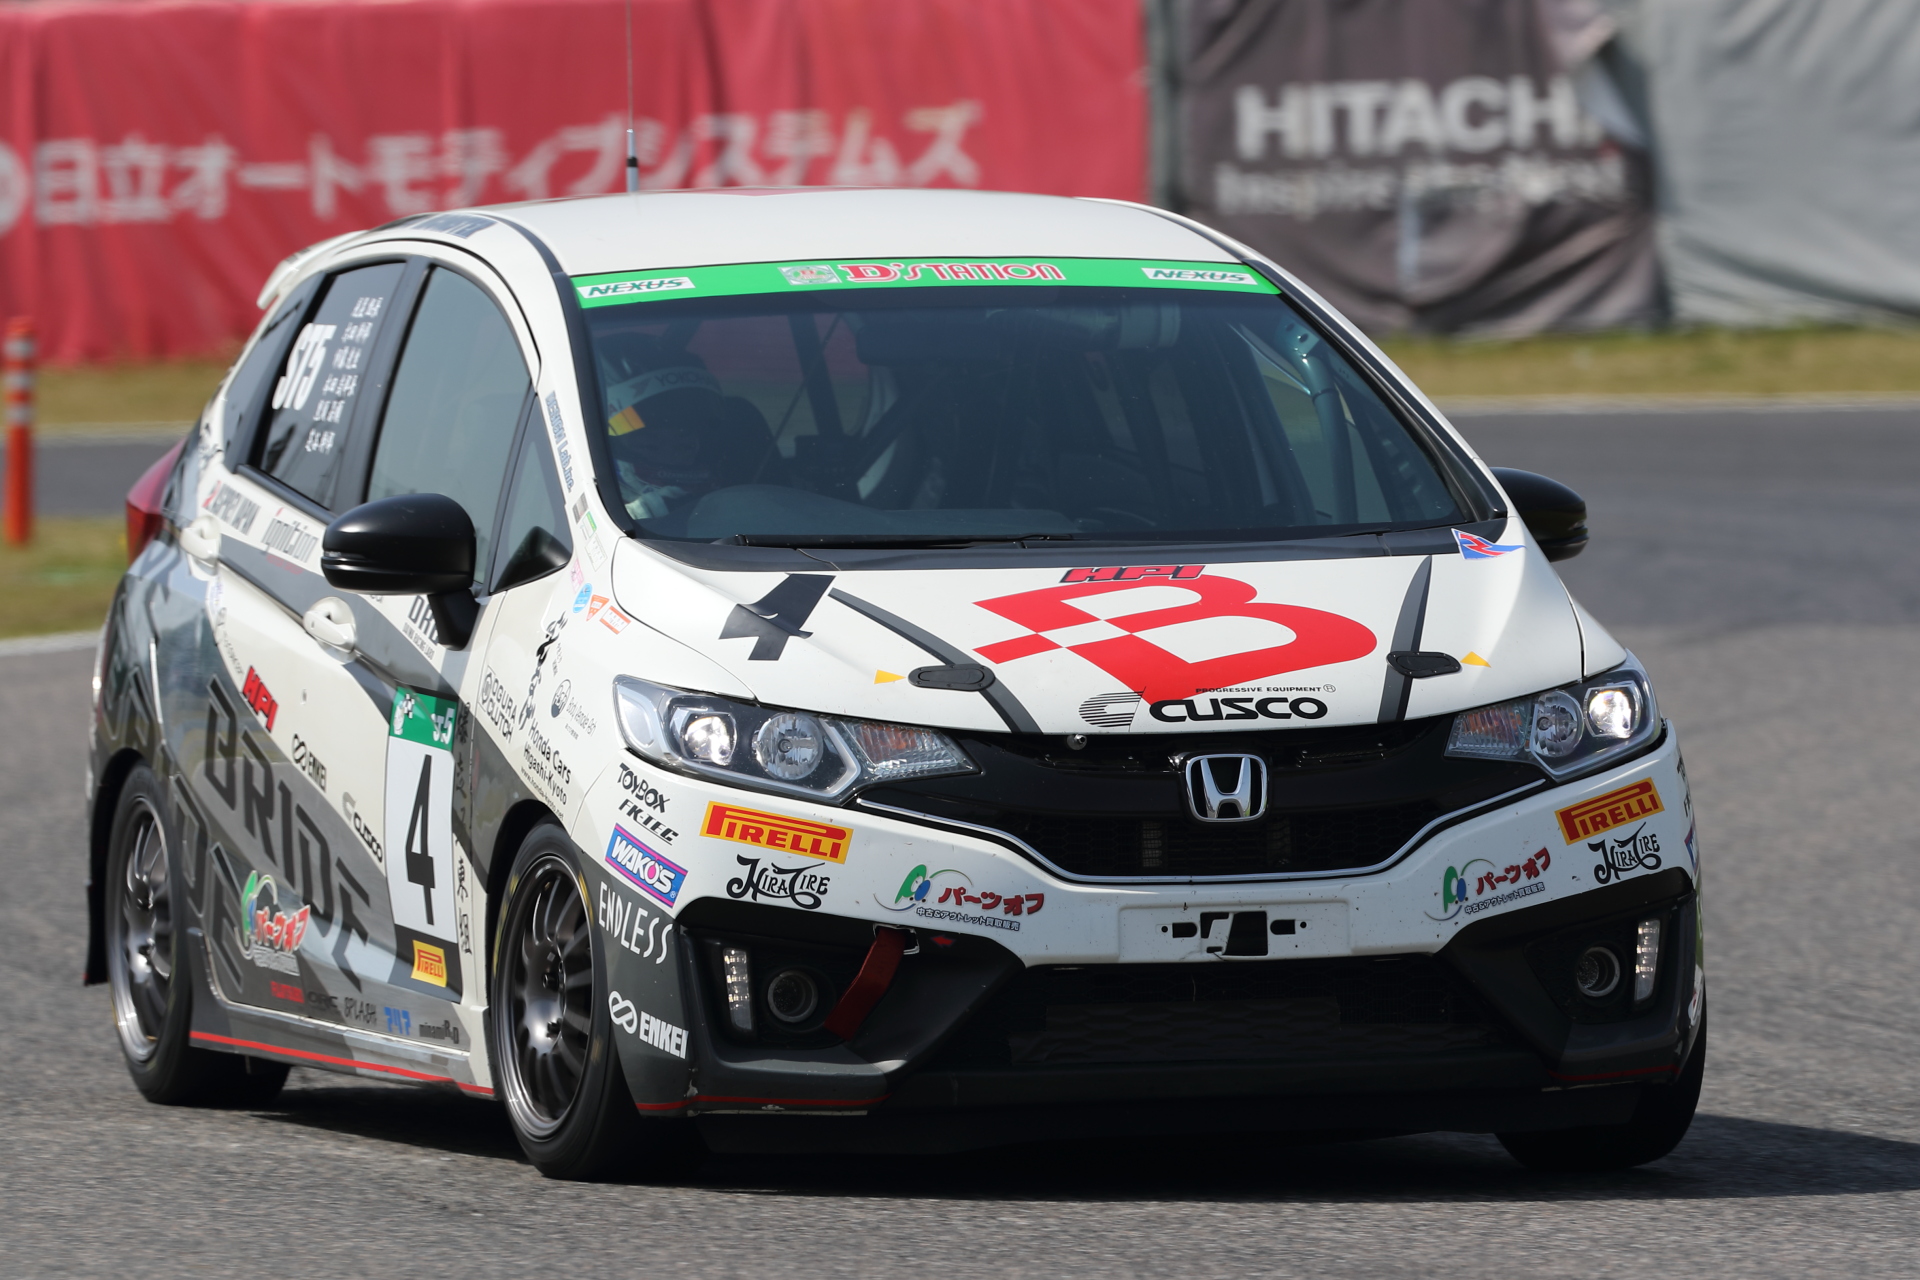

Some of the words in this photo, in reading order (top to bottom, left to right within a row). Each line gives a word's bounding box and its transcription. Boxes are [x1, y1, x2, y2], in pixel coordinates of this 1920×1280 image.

[588, 278, 686, 297] NEXUS
[838, 262, 1067, 283] D'STATION
[1152, 269, 1247, 282] NEXUS
[1059, 564, 1206, 584] HPI
[718, 573, 836, 661] 4
[241, 665, 279, 733] HPI
[486, 699, 514, 744] CLUTCH
[492, 678, 517, 725] OGURA
[1149, 696, 1328, 723] CUSCO
[307, 749, 327, 793] ENKEI
[523, 743, 567, 806] Higashi-Kyoto
[528, 718, 551, 761] Honda
[552, 749, 572, 785] Cars
[617, 762, 671, 814] TOYBOX
[1559, 781, 1659, 841] PIRELLI
[353, 811, 383, 864] CUSCO
[405, 753, 436, 926] 4
[618, 798, 679, 844] FK-TEC
[706, 804, 847, 860] PIRELLI
[610, 835, 676, 895] WAKO'S
[1476, 846, 1551, 896] パーツオフ
[598, 880, 674, 965] ENDLESS
[937, 886, 1045, 916] パーツオフ
[417, 948, 444, 979] PIRELLI
[639, 1010, 690, 1060] ENKEI
